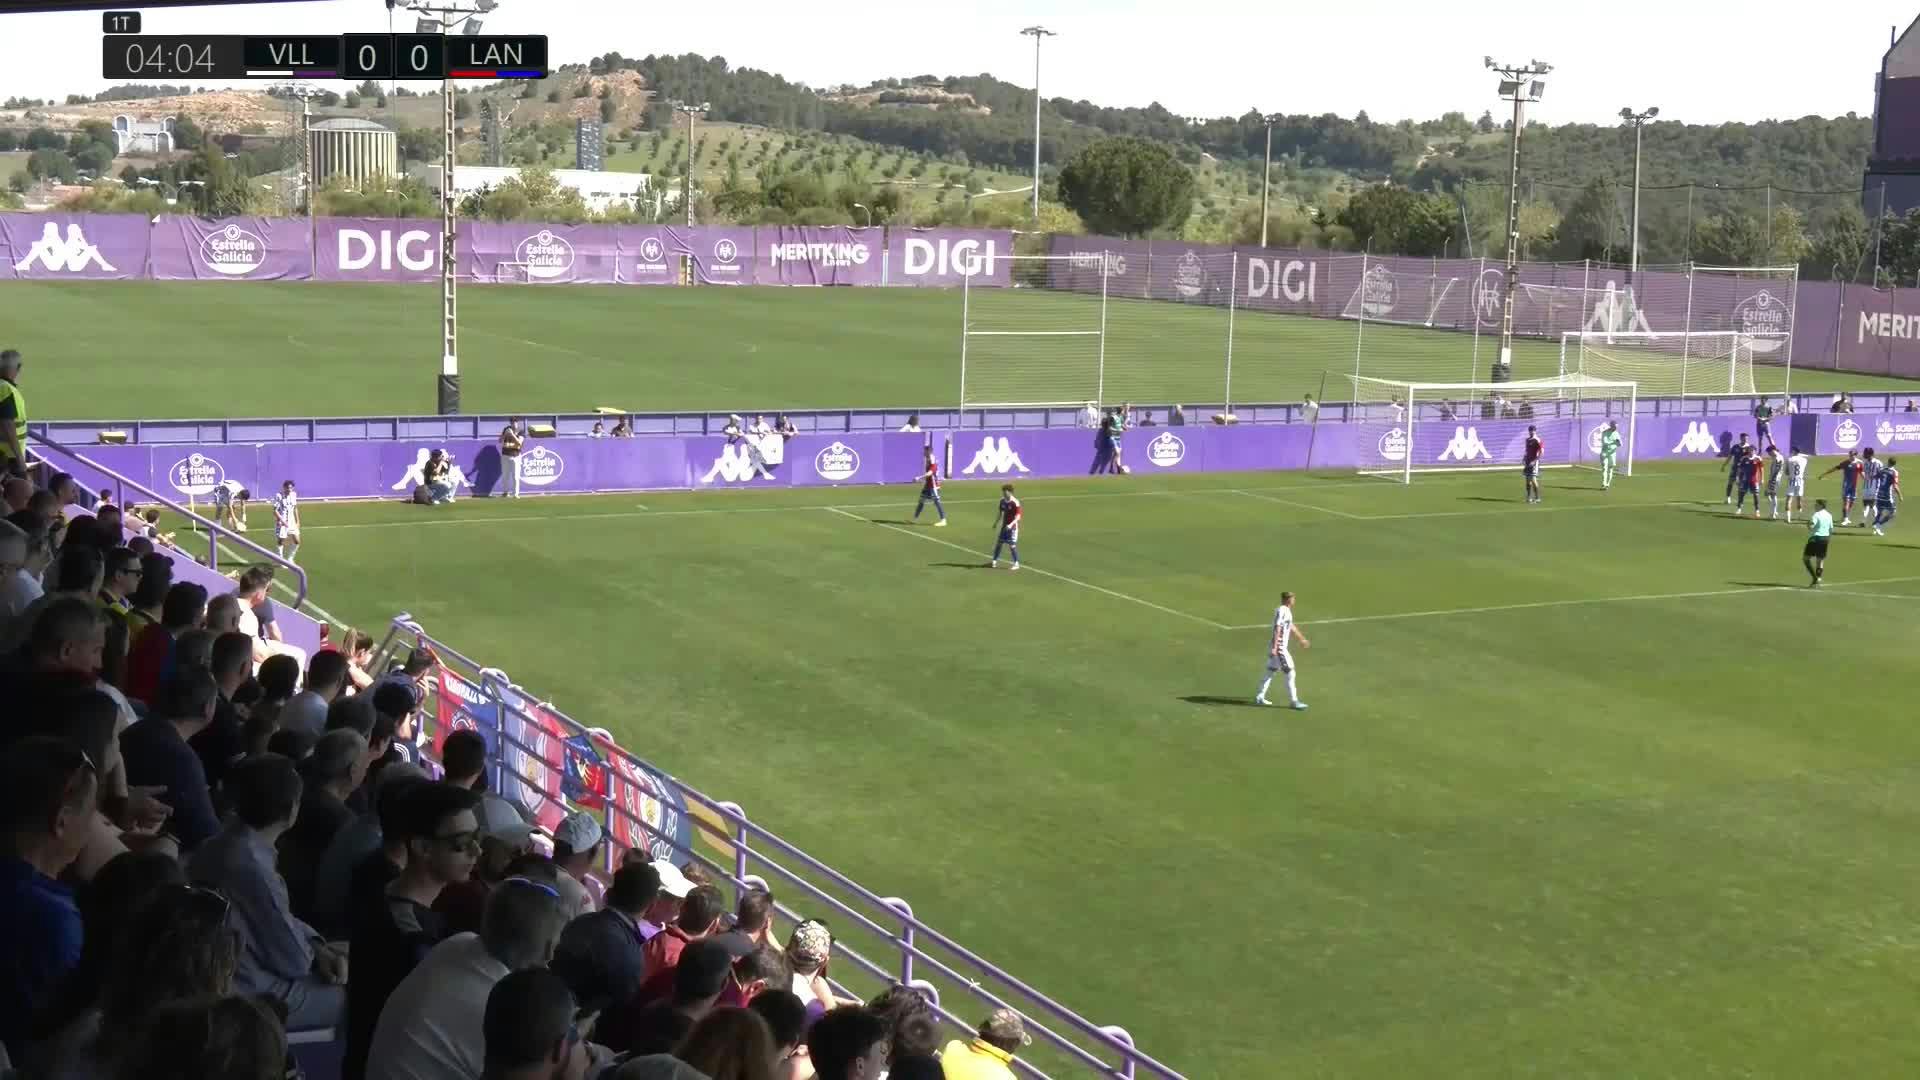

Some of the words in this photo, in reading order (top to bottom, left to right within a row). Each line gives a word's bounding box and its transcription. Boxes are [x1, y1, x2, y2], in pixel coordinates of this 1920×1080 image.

[211, 238, 255, 251] Estrella
[525, 244, 565, 255] Estrella
[212, 249, 253, 263] Galicia
[771, 243, 870, 266] MERITKING
[904, 238, 996, 276] DIGI
[1248, 257, 1317, 303] DIGI
[1742, 307, 1782, 323] Estrella
[1793, 463, 1802, 477] 8
